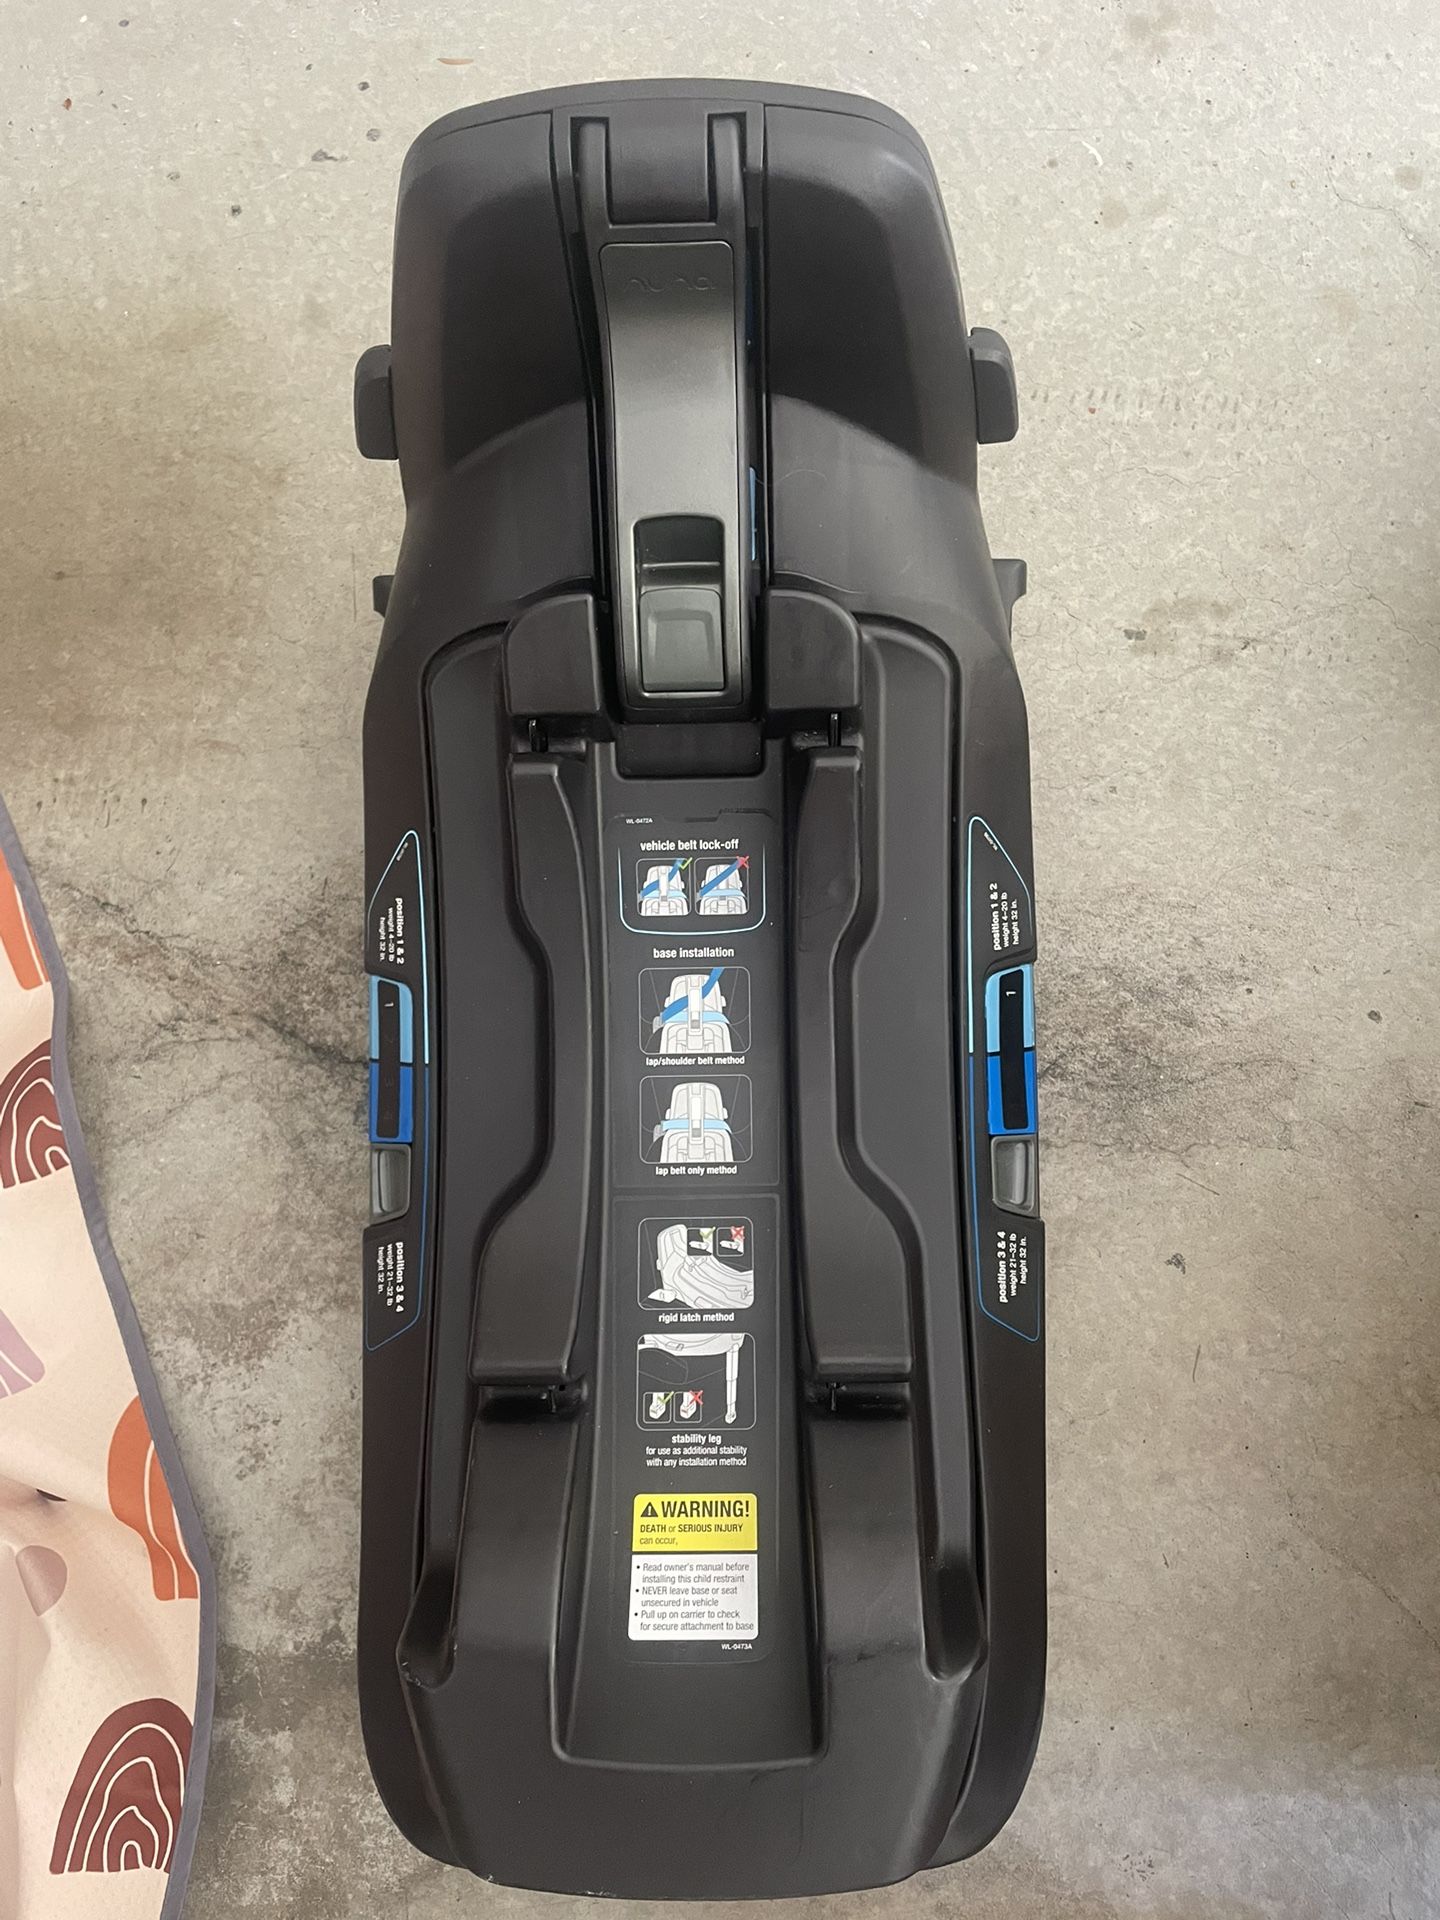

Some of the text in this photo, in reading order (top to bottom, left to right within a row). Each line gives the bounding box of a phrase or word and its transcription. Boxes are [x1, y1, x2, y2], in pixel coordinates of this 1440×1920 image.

[640, 839, 739, 851] vehicle belt lock-off
[990, 882, 998, 890] 2
[990, 891, 998, 900] &
[395, 897, 404, 937] position
[1011, 910, 1018, 920] 32
[991, 911, 1001, 951] position
[1001, 921, 1010, 948] weight
[1011, 921, 1020, 945] height
[379, 941, 386, 953] 32
[653, 947, 735, 958] base installation
[396, 957, 404, 965] 2
[698, 1057, 713, 1065] belt
[715, 1056, 745, 1065] method
[656, 1165, 737, 1176] lap belt only method
[1009, 1233, 1017, 1241] lb
[386, 1243, 394, 1270] weight
[1019, 1247, 1027, 1258] 32
[377, 1246, 385, 1271] height
[395, 1242, 405, 1283] position
[997, 1231, 1008, 1303] position 3 & 4
[1019, 1260, 1028, 1284] height
[377, 1272, 385, 1282] 32
[1009, 1269, 1018, 1296] weight
[396, 1294, 405, 1303] &
[658, 1312, 735, 1324] rigid latch method
[671, 1434, 721, 1445] stability leg
[645, 1446, 747, 1456] for use as additional stability
[646, 1457, 747, 1468] with any installation method
[661, 1500, 750, 1518] WARNING!
[640, 1524, 667, 1533] DEATH
[678, 1524, 712, 1532] SERIOUS
[714, 1523, 743, 1532] INJURY
[639, 1537, 654, 1545] can
[643, 1562, 750, 1571] Read owner's manual before
[642, 1574, 745, 1584] installing this child restraint
[642, 1587, 668, 1595] NEVER
[669, 1586, 690, 1595] leave
[691, 1586, 710, 1595] base
[721, 1587, 738, 1595] seat
[641, 1598, 719, 1607] unsecured in vehicle
[641, 1610, 655, 1619] Pull
[657, 1611, 667, 1620] up
[680, 1610, 706, 1618] carrier
[707, 1610, 715, 1618] to
[716, 1609, 740, 1618] check
[640, 1622, 754, 1631] for secure attachment to base
